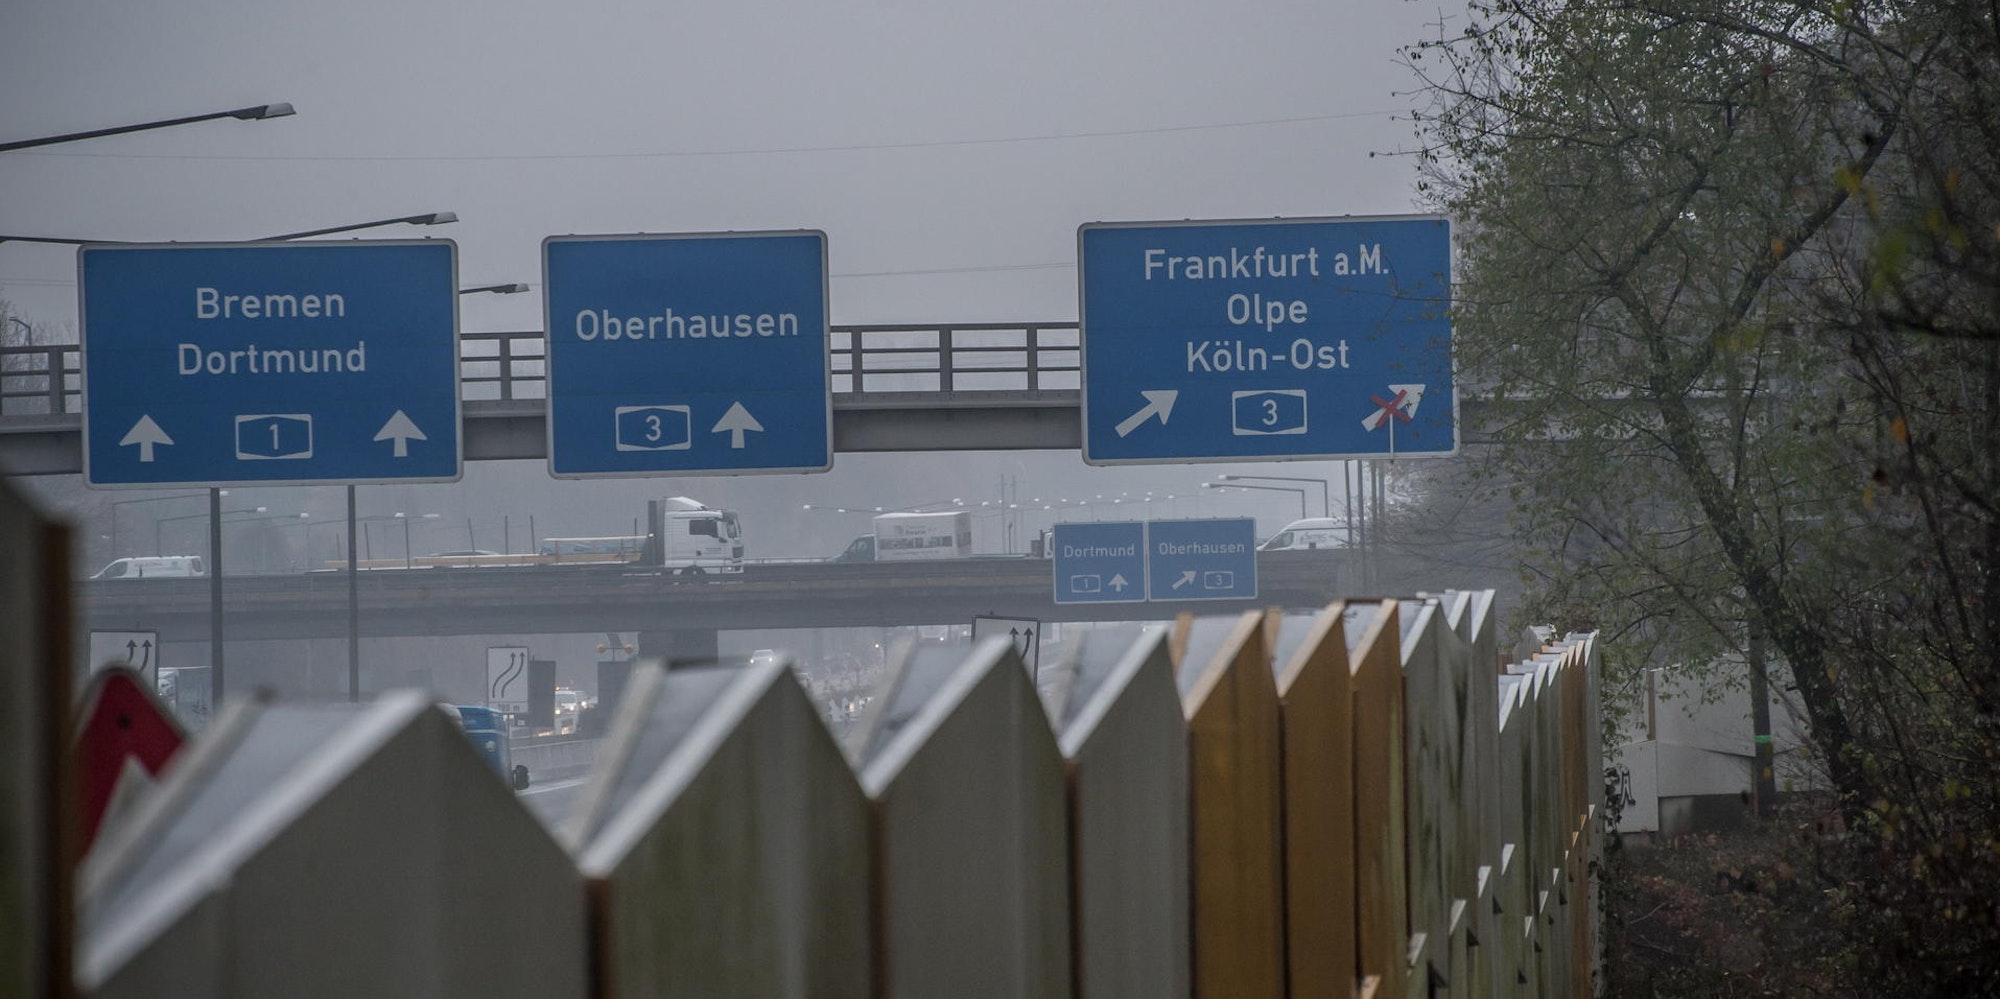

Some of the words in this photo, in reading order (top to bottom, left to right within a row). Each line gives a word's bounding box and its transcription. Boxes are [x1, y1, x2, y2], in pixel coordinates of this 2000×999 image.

[1144, 247, 1319, 280] Frankfurt
[1334, 243, 1389, 276] a.M.
[196, 287, 344, 319] Bremen
[1227, 293, 1308, 332] Olpe
[575, 308, 798, 341] Oberhausen
[178, 341, 366, 375] Dortmund
[1187, 339, 1349, 373] Köln-Ost
[1261, 399, 1278, 426] 3
[269, 423, 279, 450] 1
[645, 415, 661, 442] 3
[1064, 543, 1135, 559] Dortmund
[1158, 542, 1245, 556] Oberhausen
[1215, 574, 1223, 586] 3
